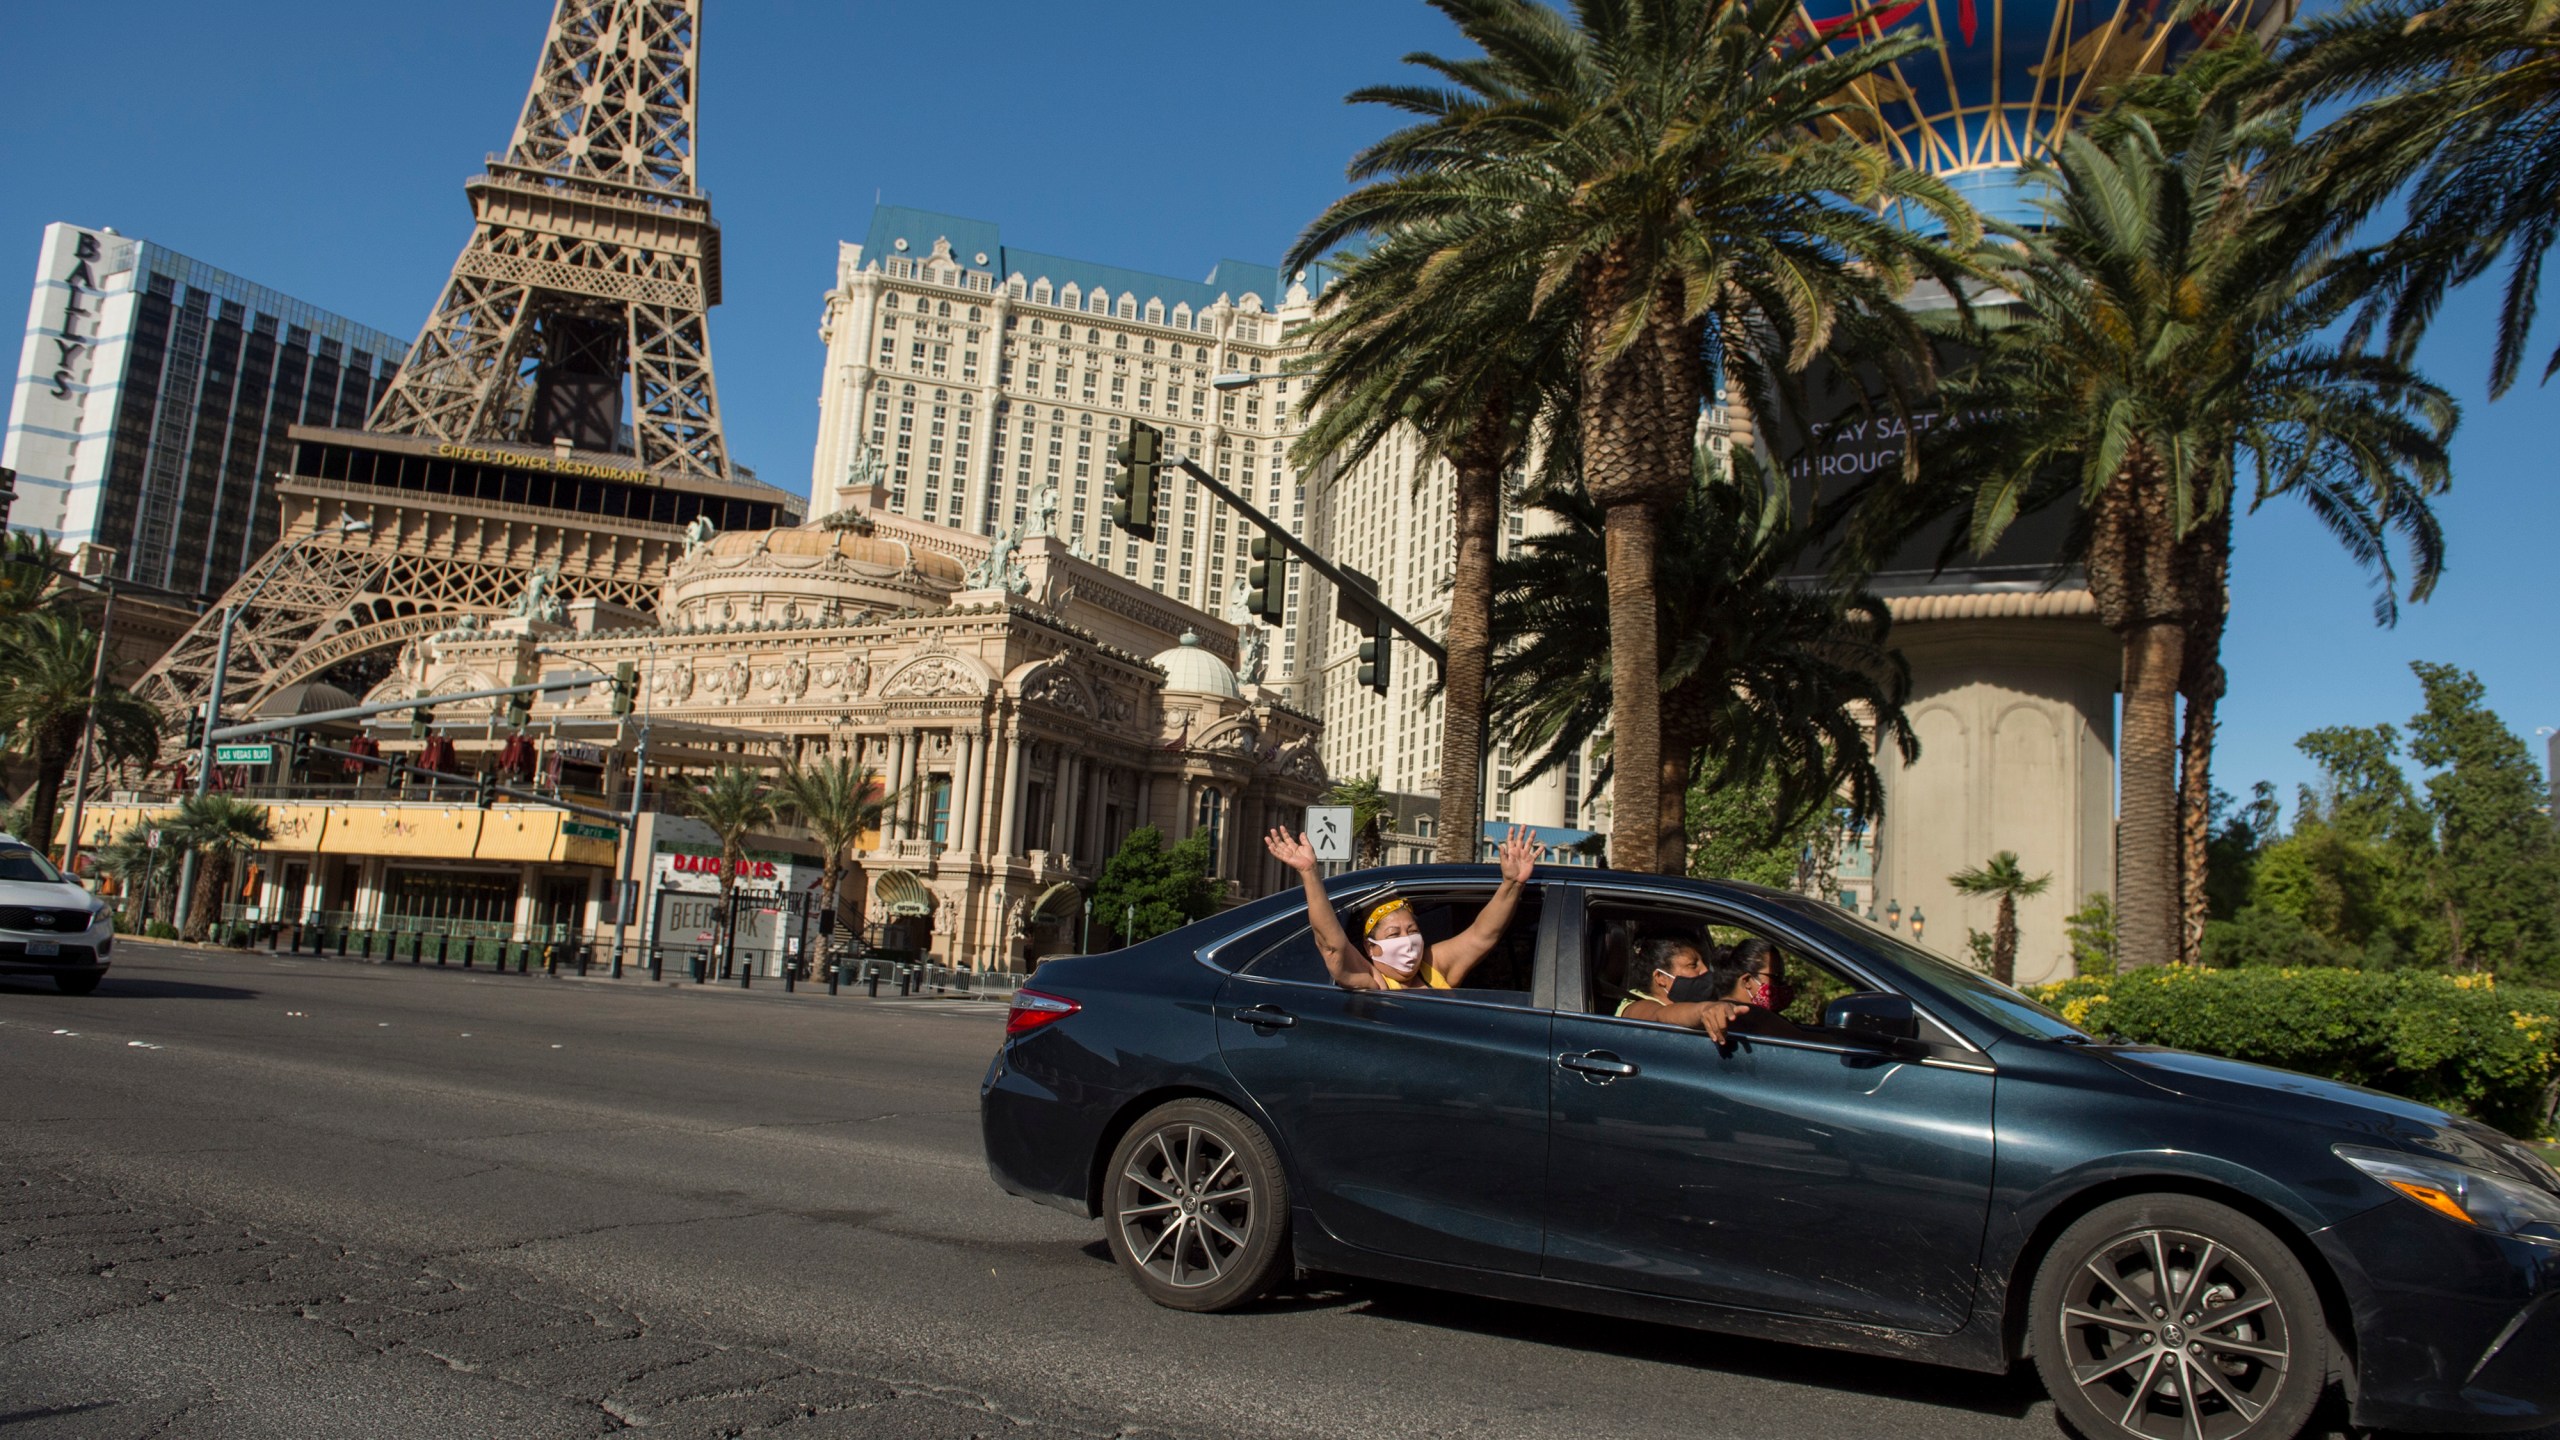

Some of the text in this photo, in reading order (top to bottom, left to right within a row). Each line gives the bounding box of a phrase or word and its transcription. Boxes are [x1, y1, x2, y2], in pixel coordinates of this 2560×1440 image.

[1810, 419, 1868, 442] SAY
[438, 443, 648, 484] EIFFEL TOWER RESTAURANT
[1792, 450, 1904, 478] HROUG
[218, 749, 268, 760] LAS VEGAS BLVD
[577, 824, 603, 838] Paris
[673, 853, 777, 880] DAIQIRIS
[670, 902, 714, 931] BEER
